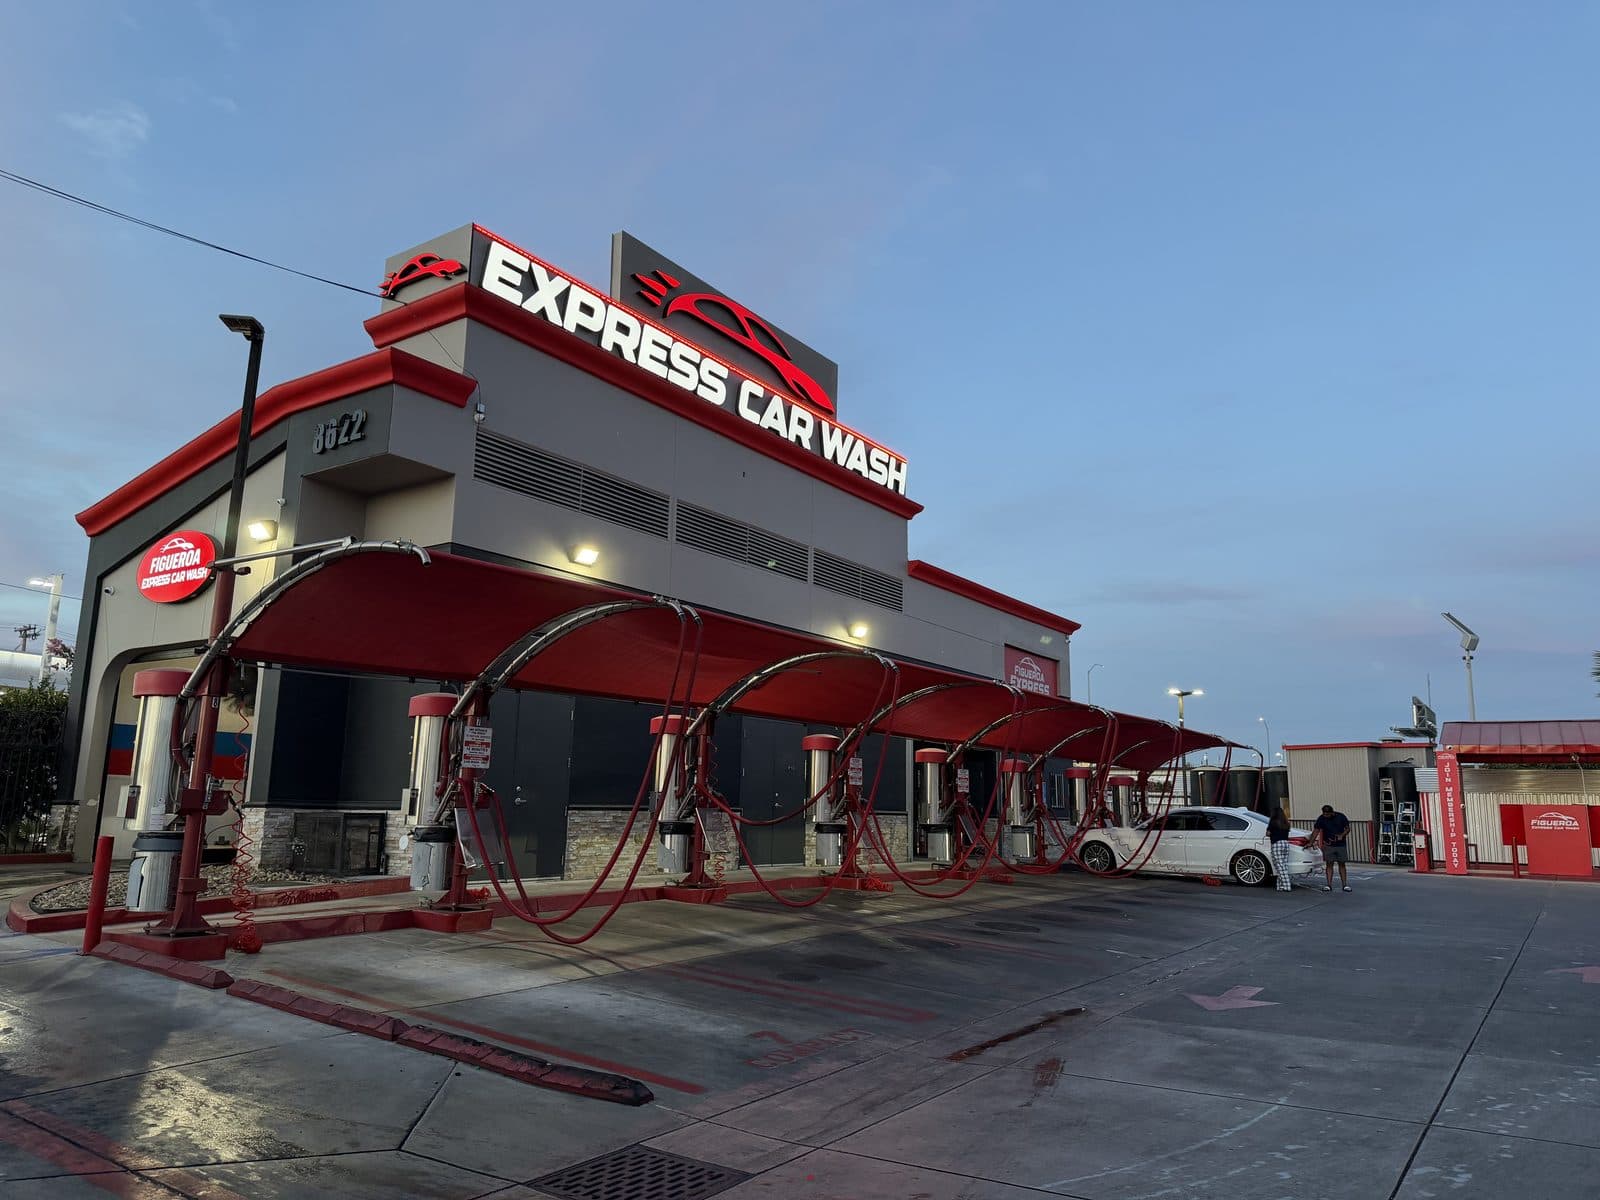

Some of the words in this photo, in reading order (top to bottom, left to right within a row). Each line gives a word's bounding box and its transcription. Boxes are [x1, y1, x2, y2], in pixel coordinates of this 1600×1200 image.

[482, 241, 728, 406] EXPRESS
[738, 379, 814, 450] CAR
[821, 420, 907, 495] WASH
[312, 409, 366, 454] 8622
[149, 548, 201, 574] FIGUEROA
[141, 573, 171, 589] EXPRESS
[171, 571, 185, 584] CAR
[187, 567, 207, 581] WASH
[1010, 675, 1050, 695] EXPRESS
[1014, 665, 1045, 682] FIGUEROA
[1444, 762, 1452, 782] JOIN
[1451, 842, 1459, 868] TODAY
